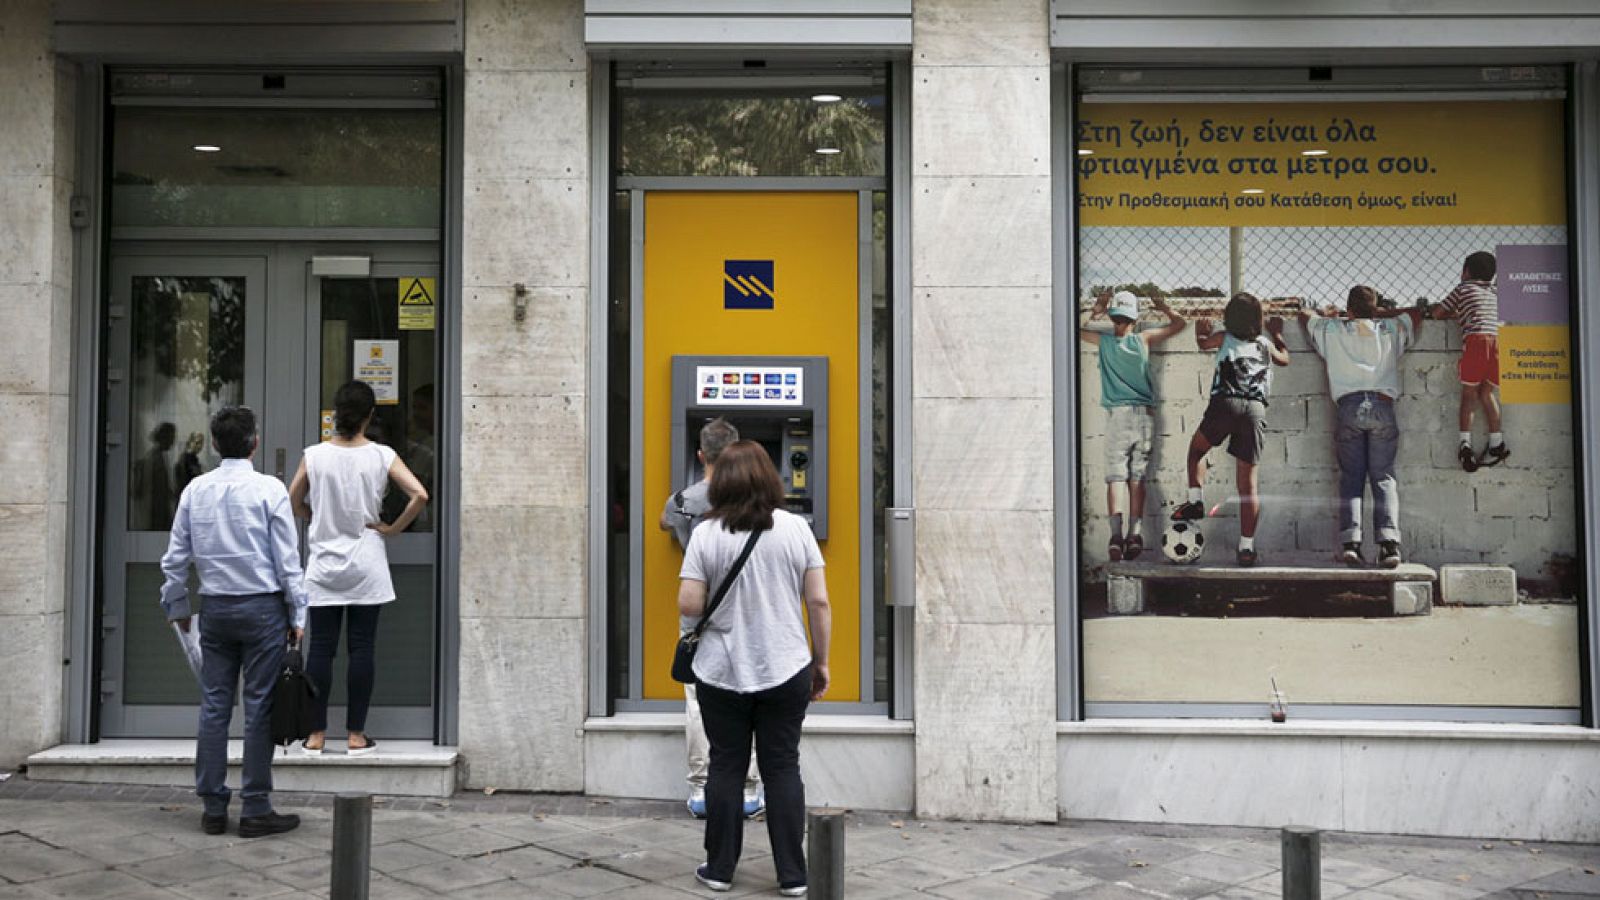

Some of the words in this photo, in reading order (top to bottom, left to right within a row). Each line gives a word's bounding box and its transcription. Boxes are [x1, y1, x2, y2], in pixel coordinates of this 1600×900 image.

[1079, 119, 1121, 147] Στη
[1130, 118, 1190, 148] ζωή,
[1199, 118, 1245, 143] δεν
[1252, 117, 1319, 143] είναι
[1326, 117, 1377, 142] όλα
[1079, 149, 1221, 180] φτιαγμένα
[1227, 156, 1279, 175] στα
[1377, 156, 1437, 175] σου.
[1079, 193, 1114, 210] Στην
[1118, 192, 1230, 210] Προθεσμιακή
[1234, 195, 1266, 208] σου
[1270, 192, 1353, 210] Κατάθεση
[1357, 191, 1407, 210] όμως,
[1411, 191, 1457, 207] είναι!
